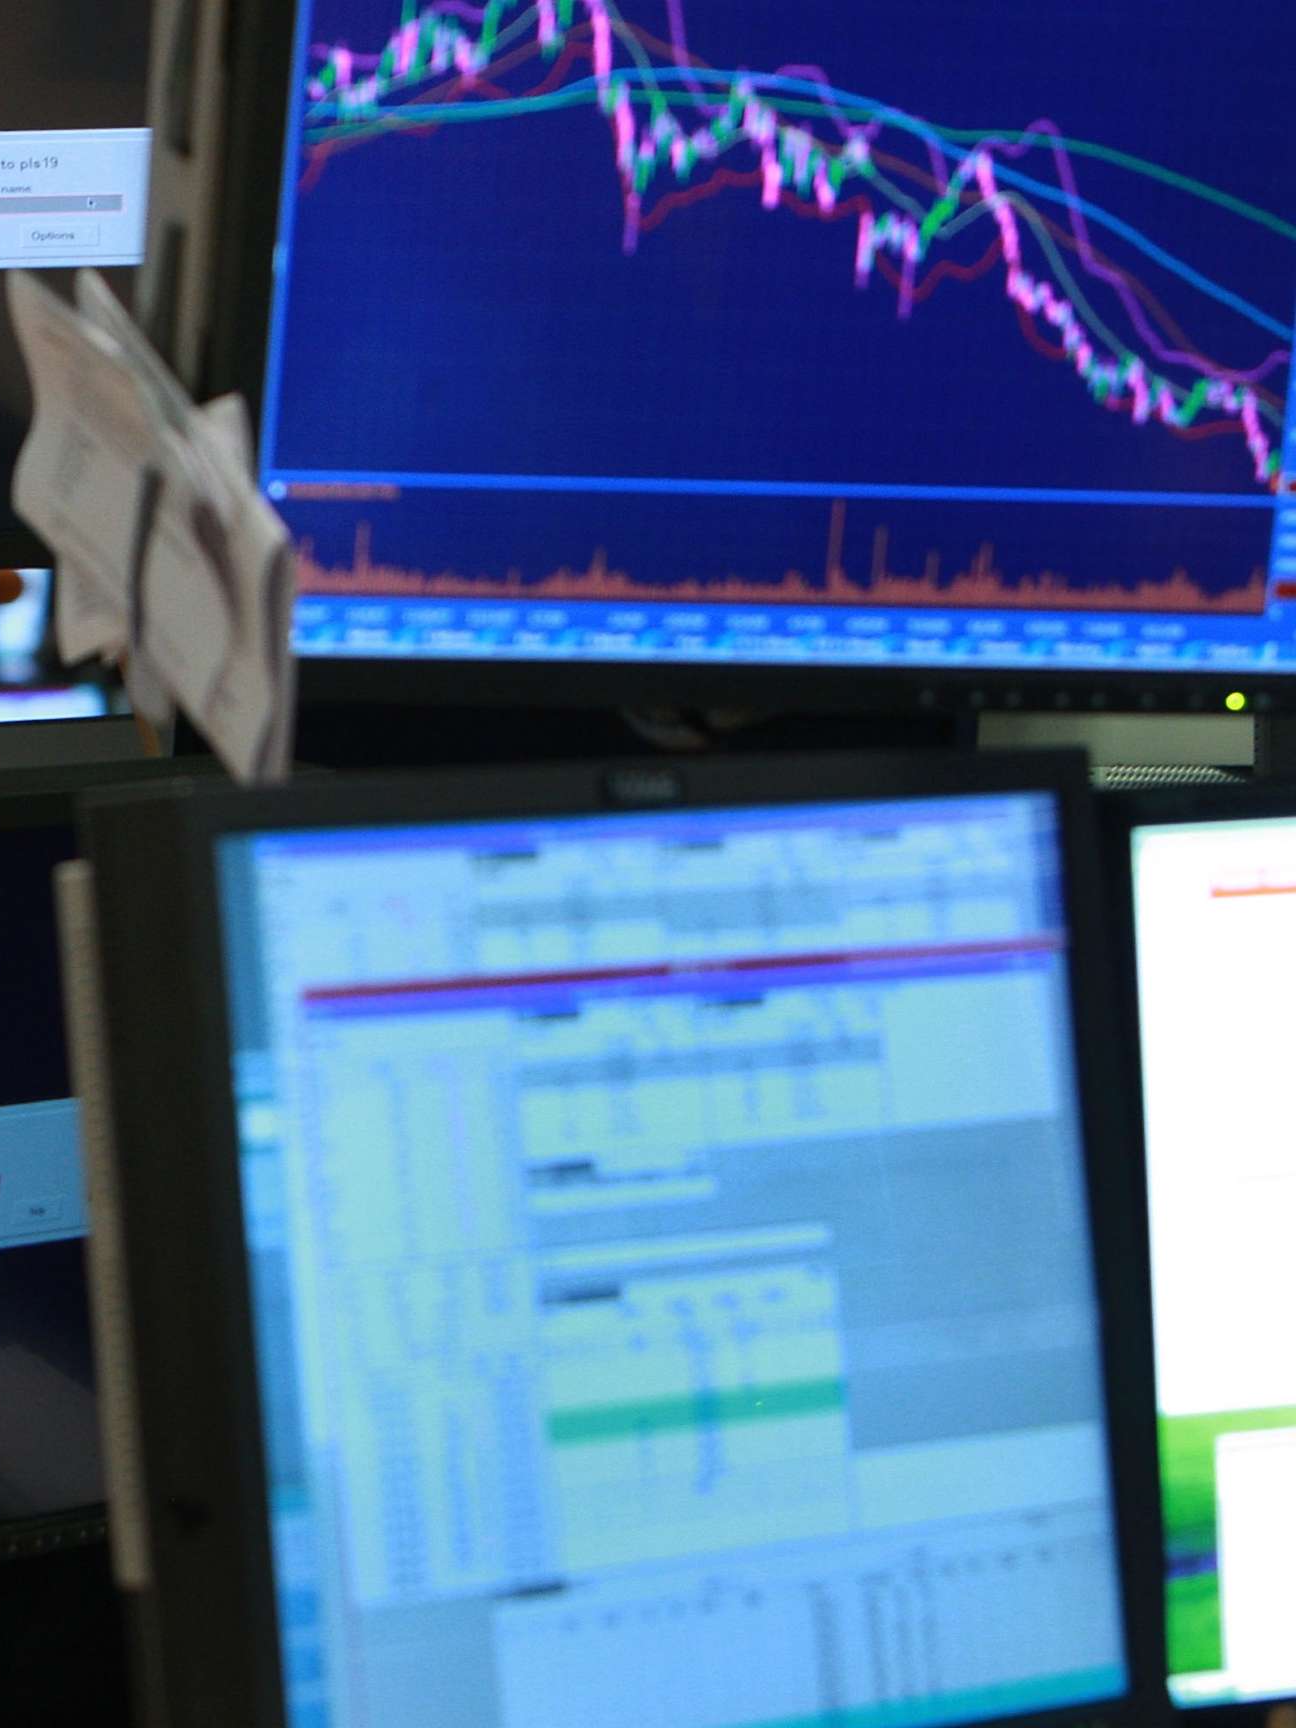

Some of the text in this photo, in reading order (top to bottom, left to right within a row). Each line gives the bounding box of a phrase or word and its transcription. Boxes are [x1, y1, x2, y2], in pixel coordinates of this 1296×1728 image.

[0, 158, 15, 170] to
[19, 156, 59, 172] pls19
[0, 184, 32, 194] name
[30, 230, 76, 243] Options
